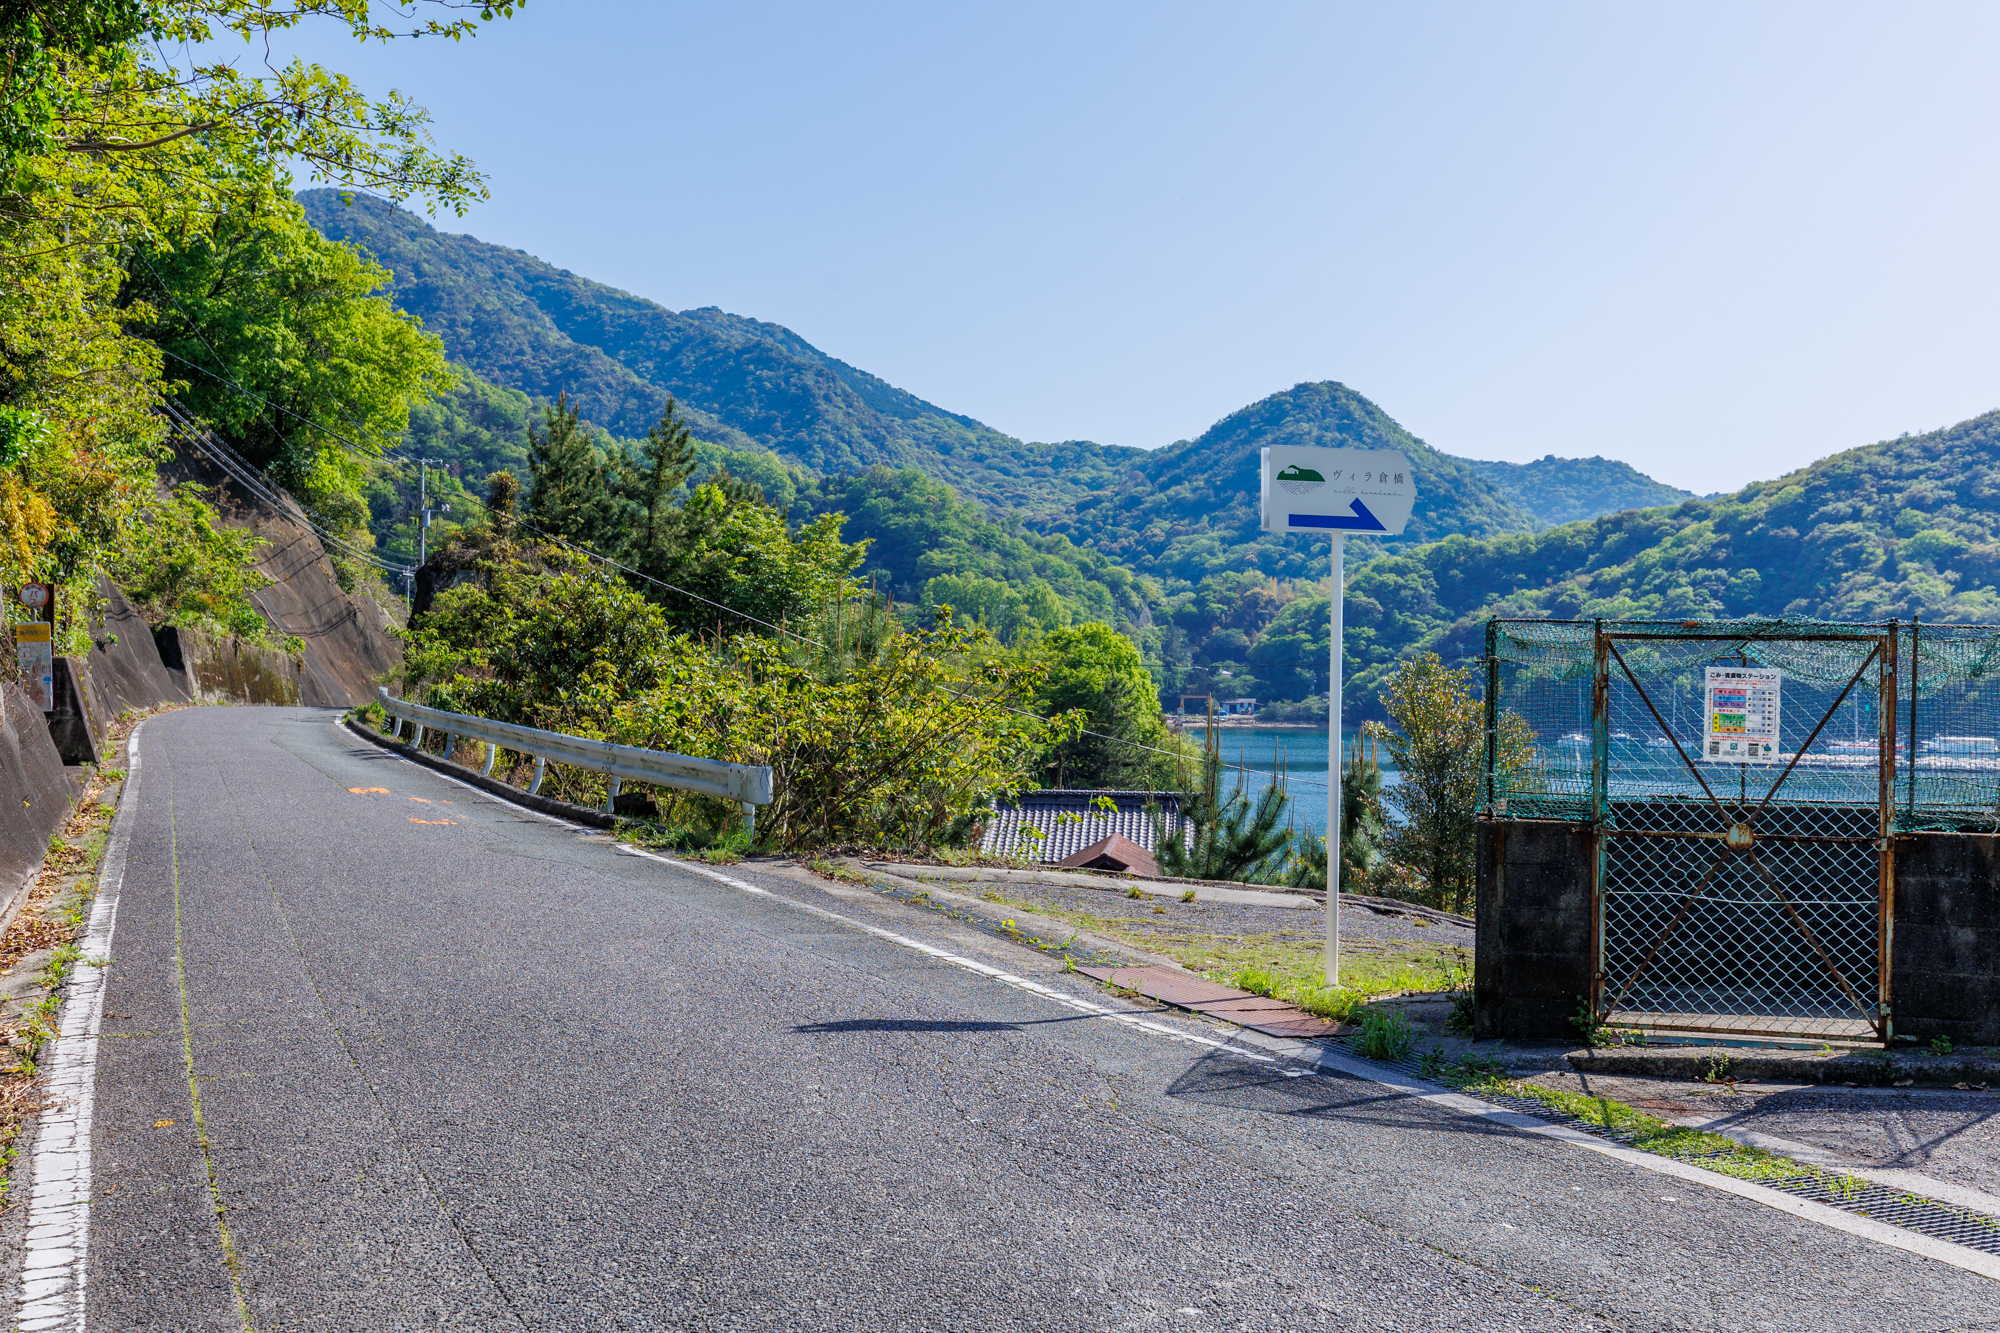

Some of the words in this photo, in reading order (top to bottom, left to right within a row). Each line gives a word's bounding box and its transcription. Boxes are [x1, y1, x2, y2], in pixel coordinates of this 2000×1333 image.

[1333, 469, 1404, 485] ヴィラ倉橋
[29, 591, 38, 606] バス
